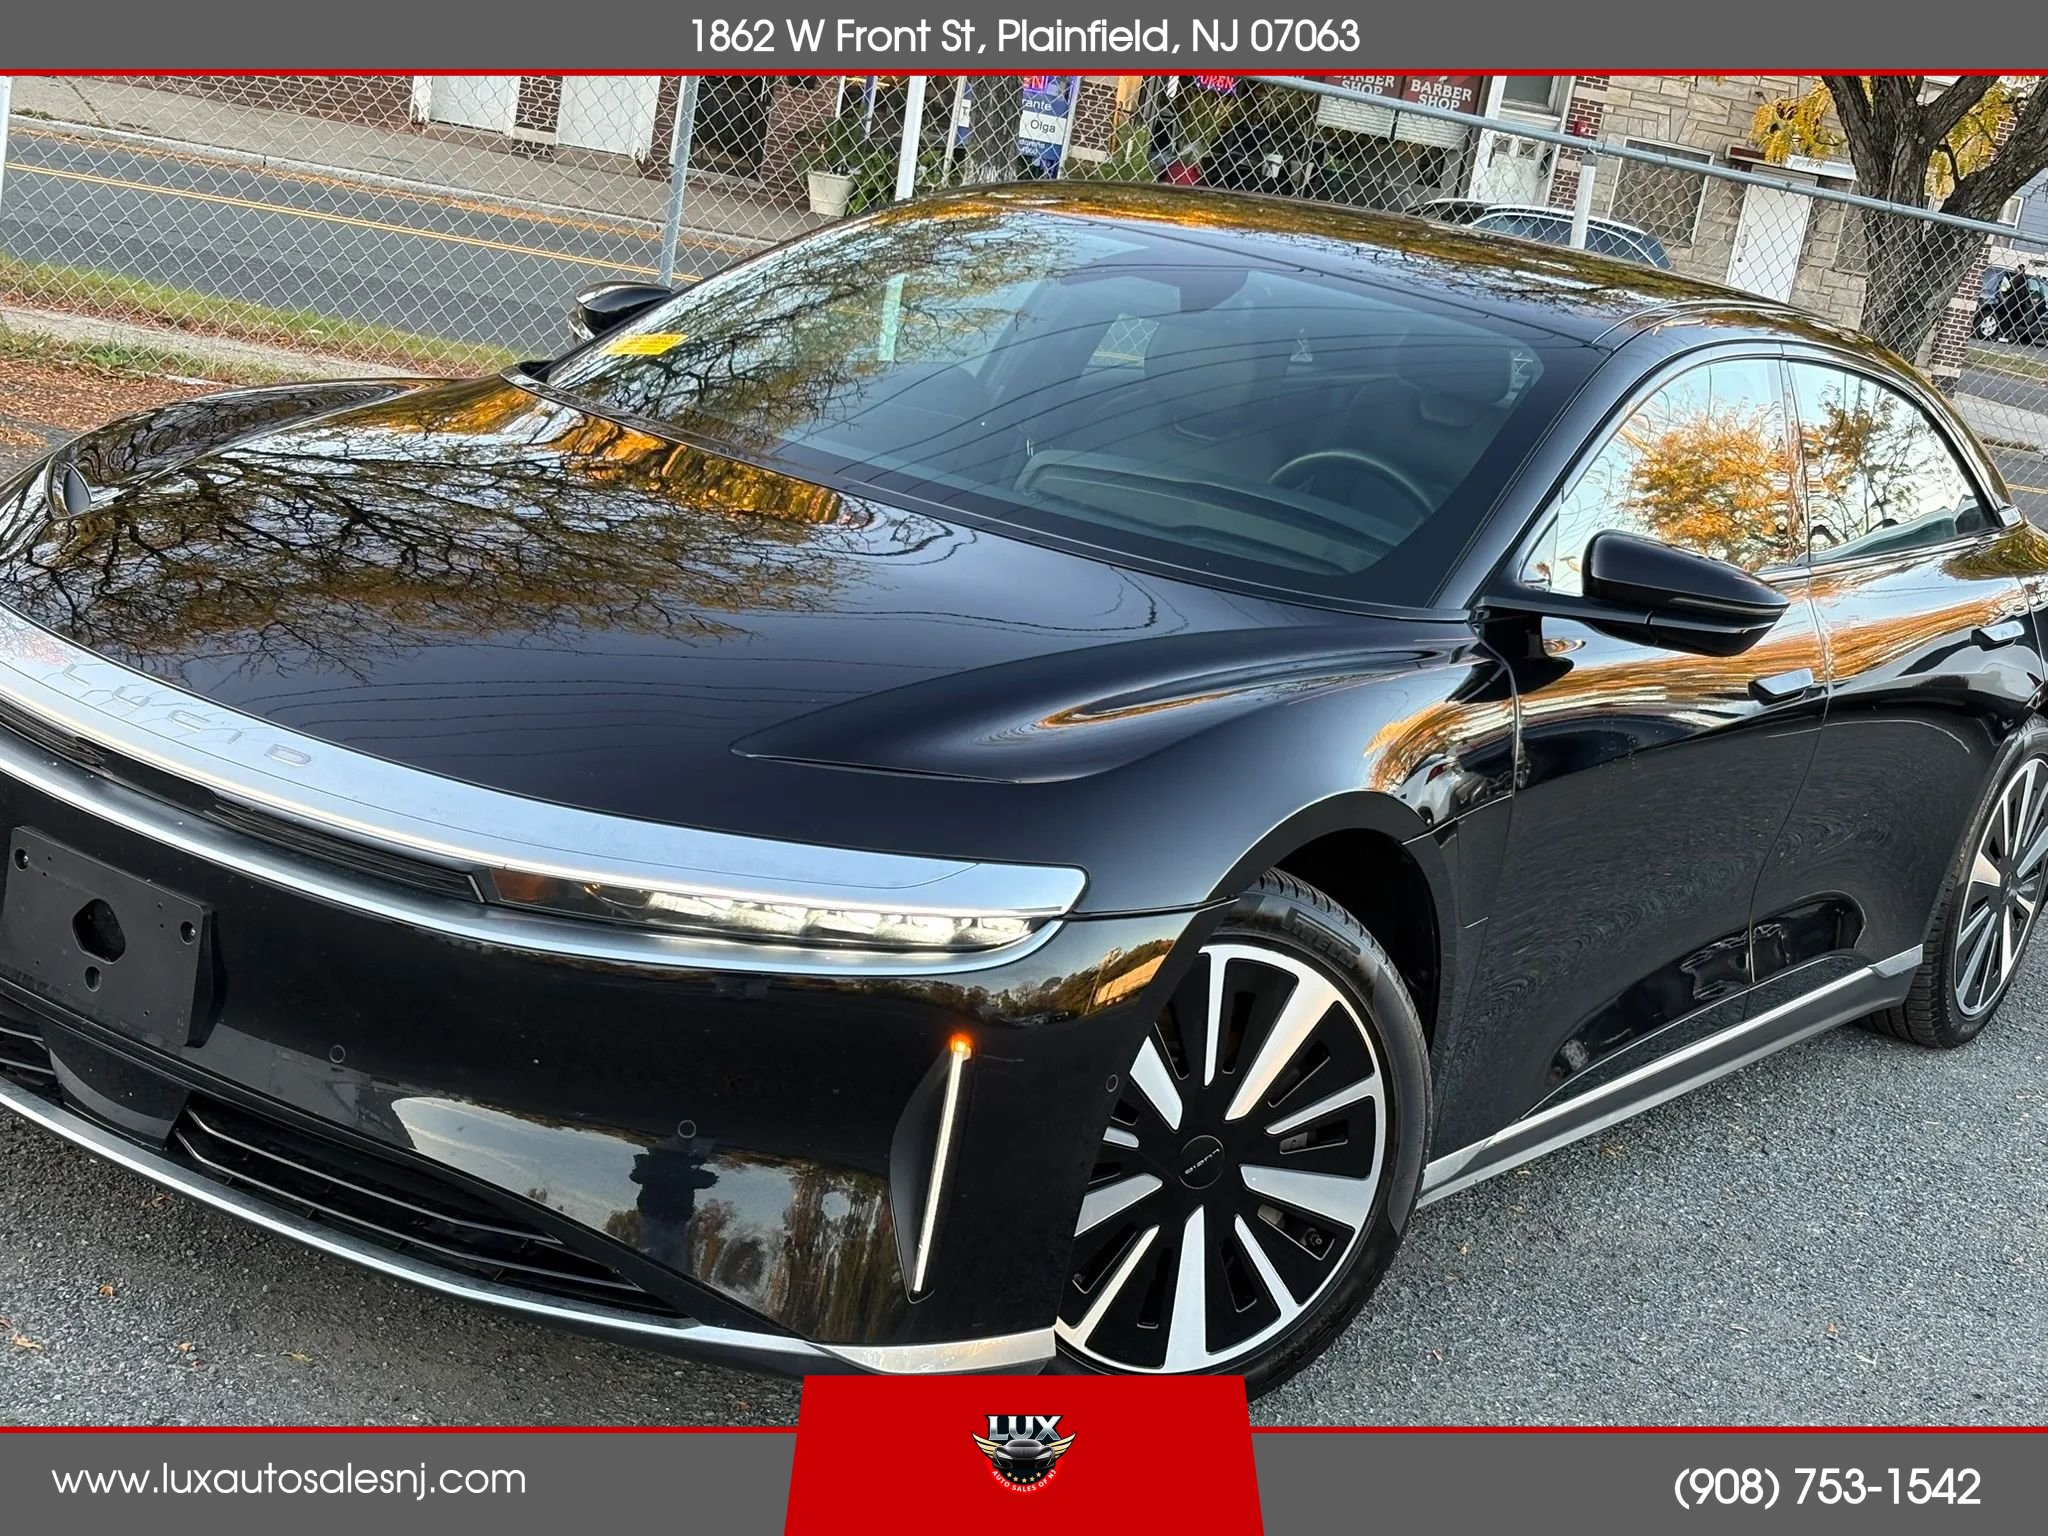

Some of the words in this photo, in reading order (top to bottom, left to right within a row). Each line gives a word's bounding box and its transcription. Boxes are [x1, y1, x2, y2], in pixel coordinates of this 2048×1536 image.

[1333, 75, 1395, 88] RBER
[1410, 79, 1473, 102] BARBER
[1418, 94, 1461, 111] SHOP
[1030, 119, 1057, 134] Olga
